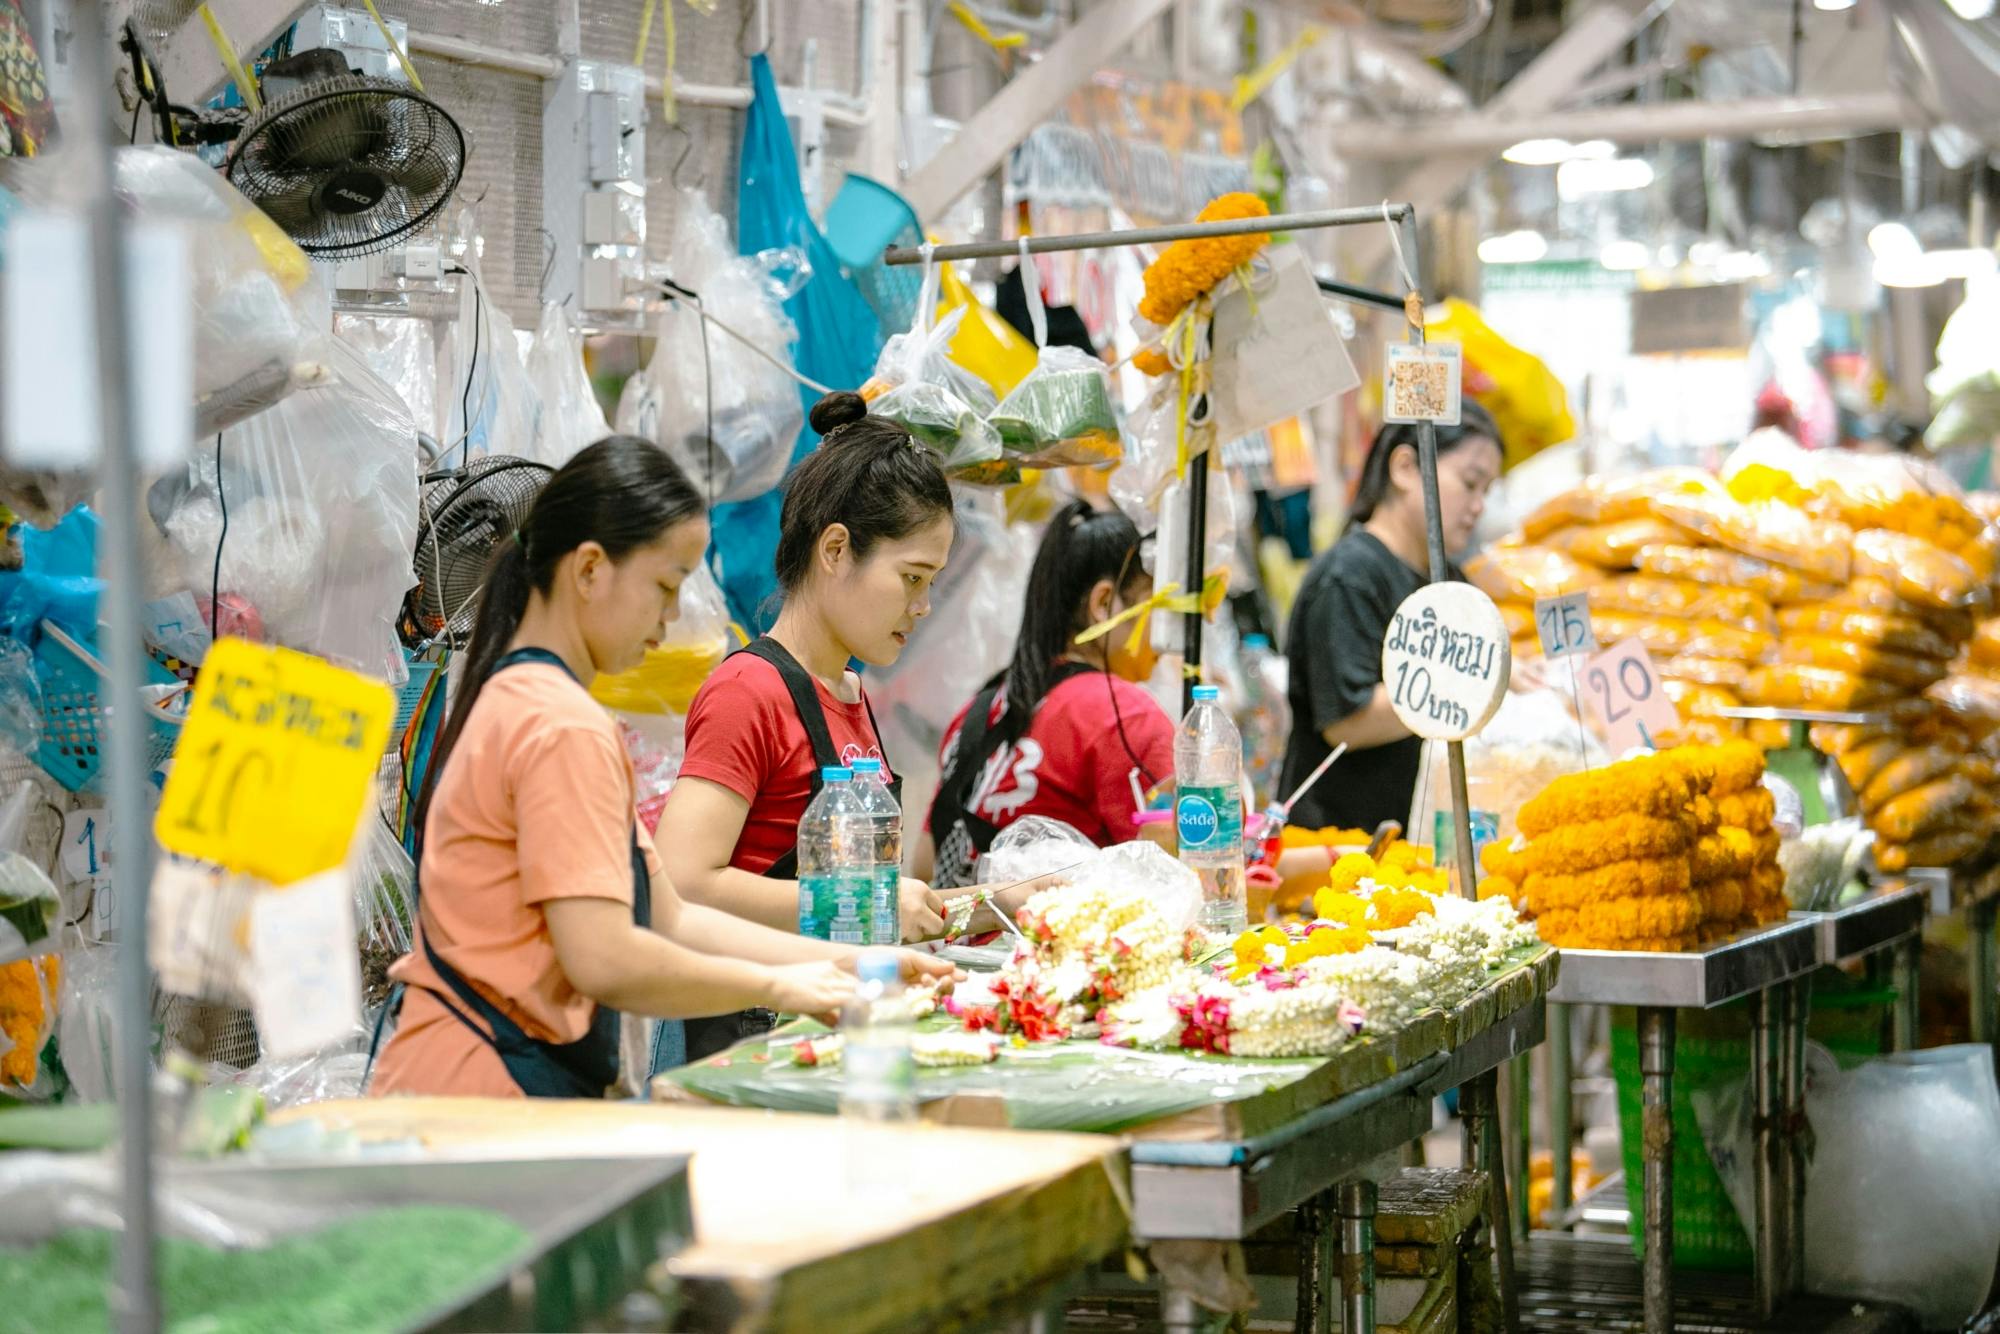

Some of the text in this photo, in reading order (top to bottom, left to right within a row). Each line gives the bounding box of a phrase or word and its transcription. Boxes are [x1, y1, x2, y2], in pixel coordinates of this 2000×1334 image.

[336, 188, 372, 204] AIKO
[1388, 607, 1496, 680] มะลิหอม
[1542, 605, 1585, 652] 15
[1588, 656, 1652, 723] 20
